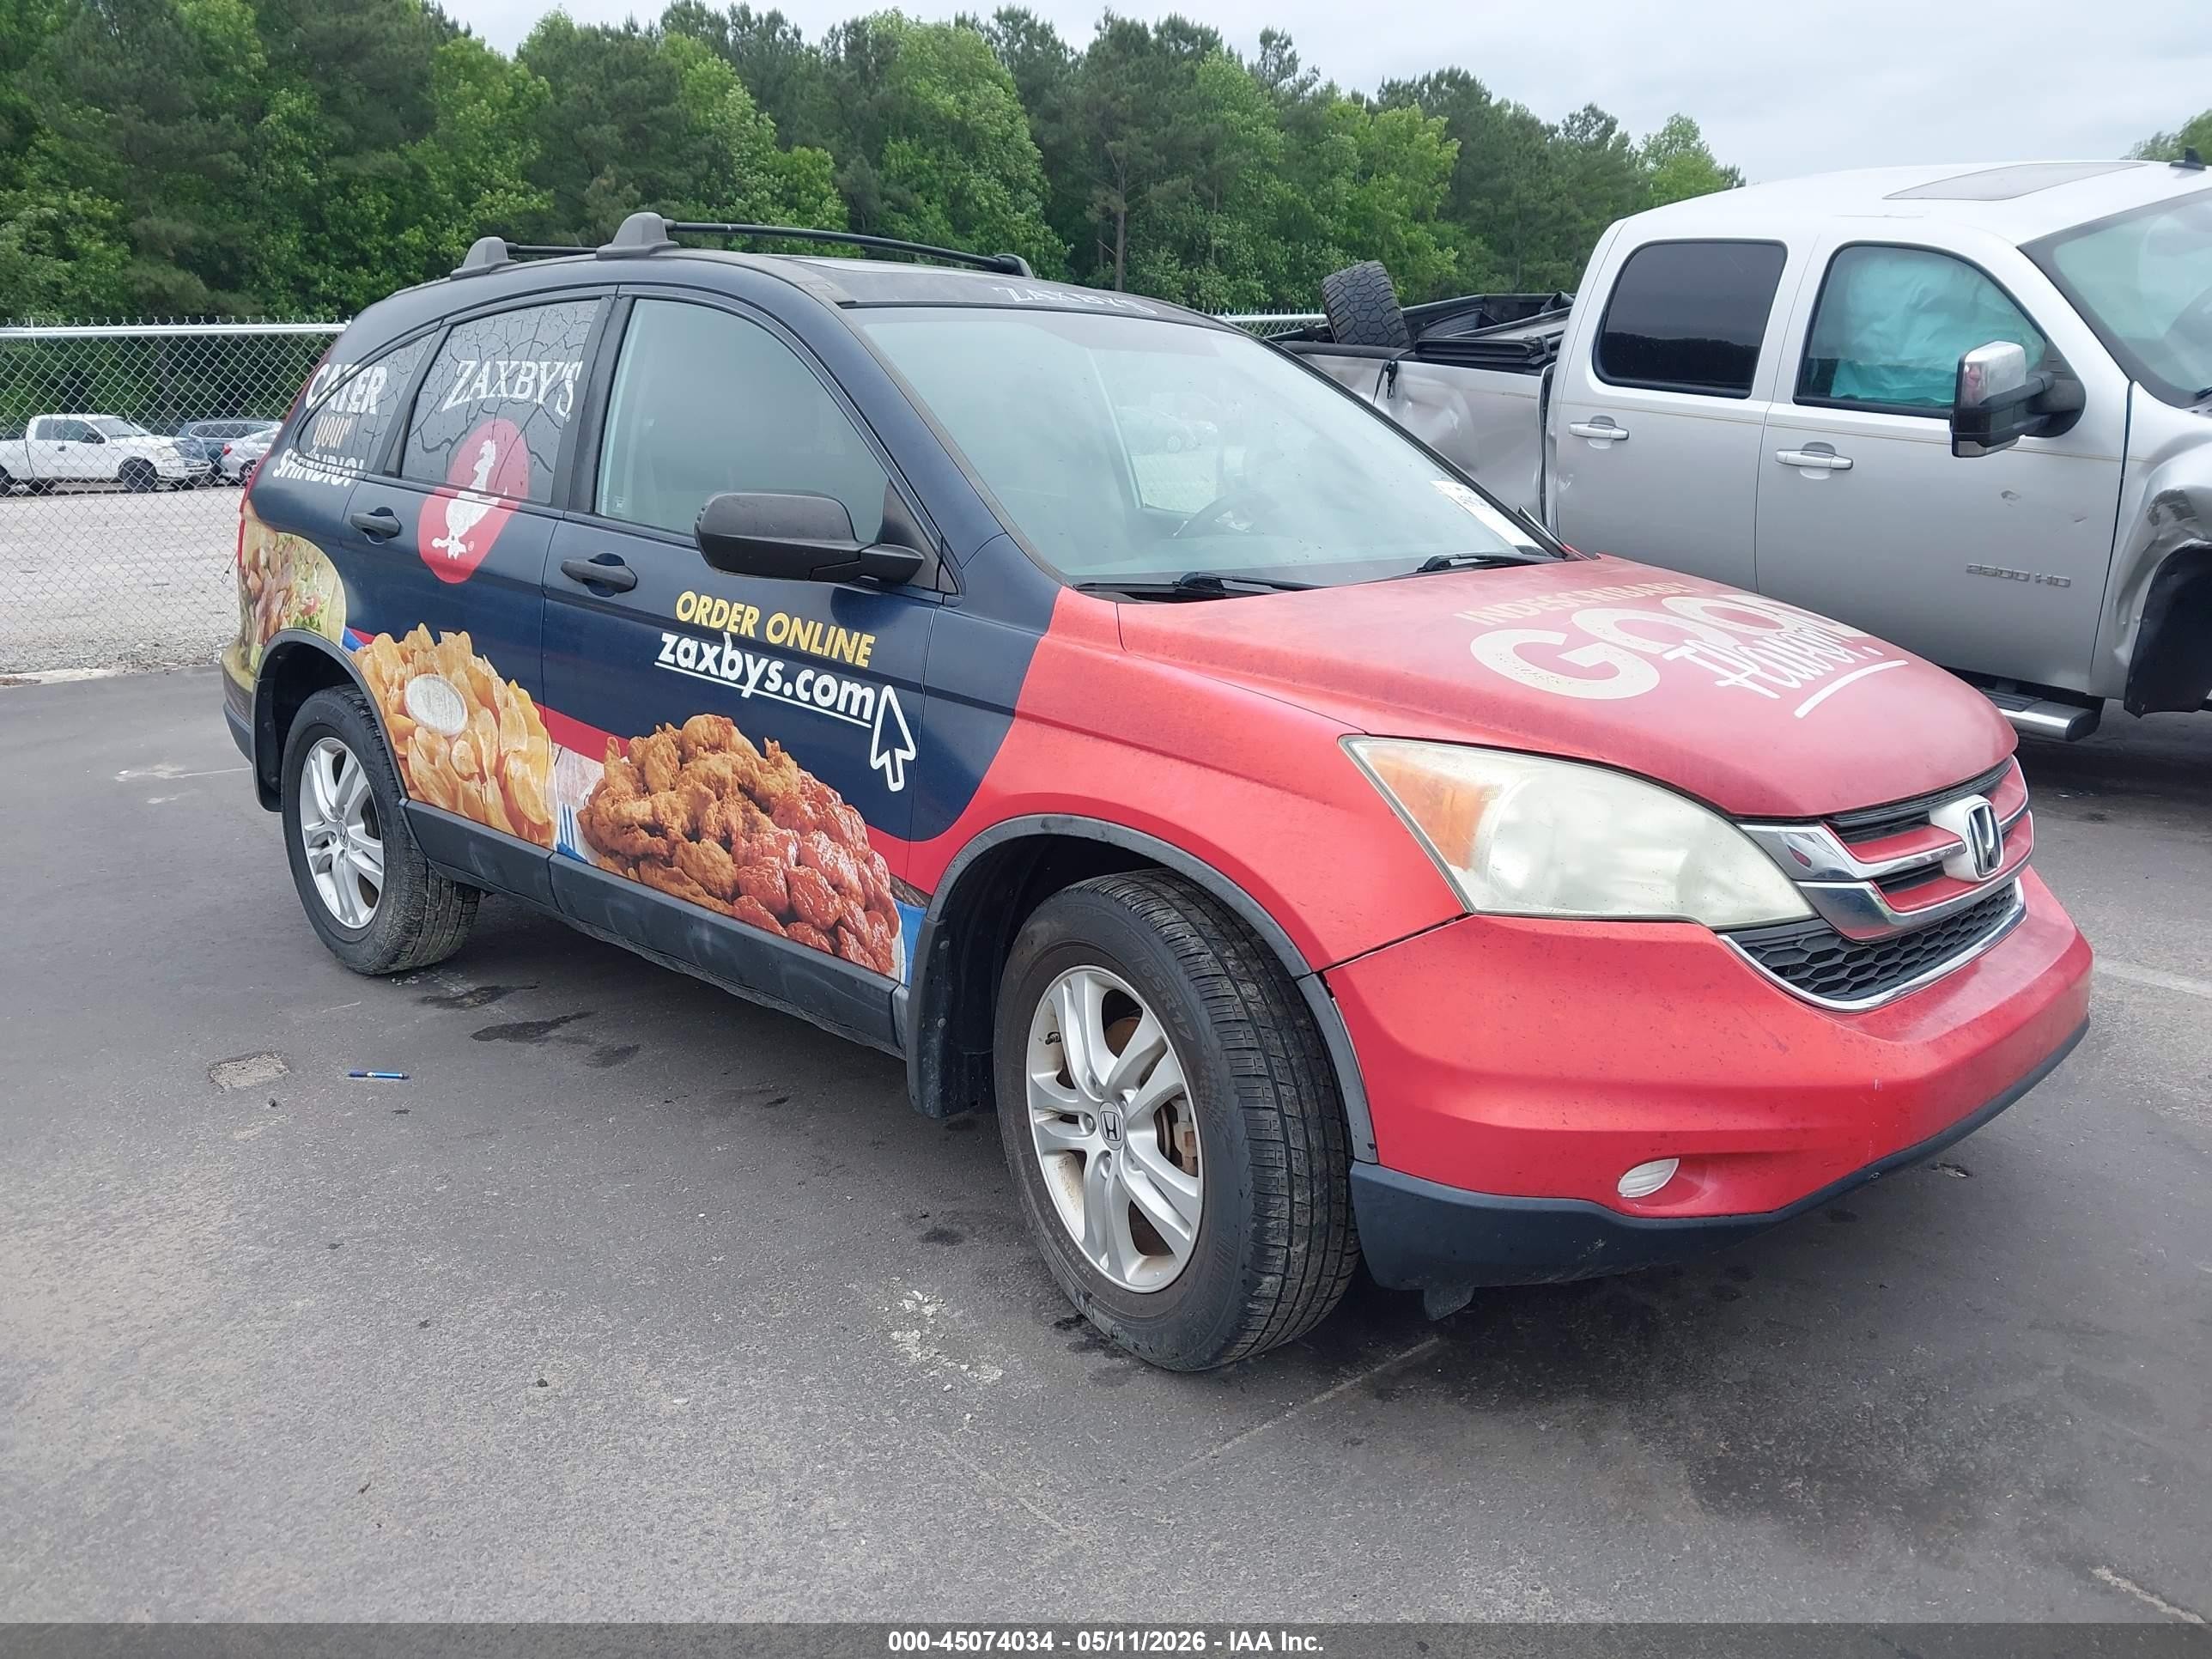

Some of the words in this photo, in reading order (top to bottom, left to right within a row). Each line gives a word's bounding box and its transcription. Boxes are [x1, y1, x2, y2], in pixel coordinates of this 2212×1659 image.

[306, 363, 387, 415] CATER
[441, 360, 583, 418] ZAXBY'S
[675, 590, 761, 638] ORDER
[765, 611, 878, 668] ONLINE
[657, 632, 877, 722] zaxbys.com
